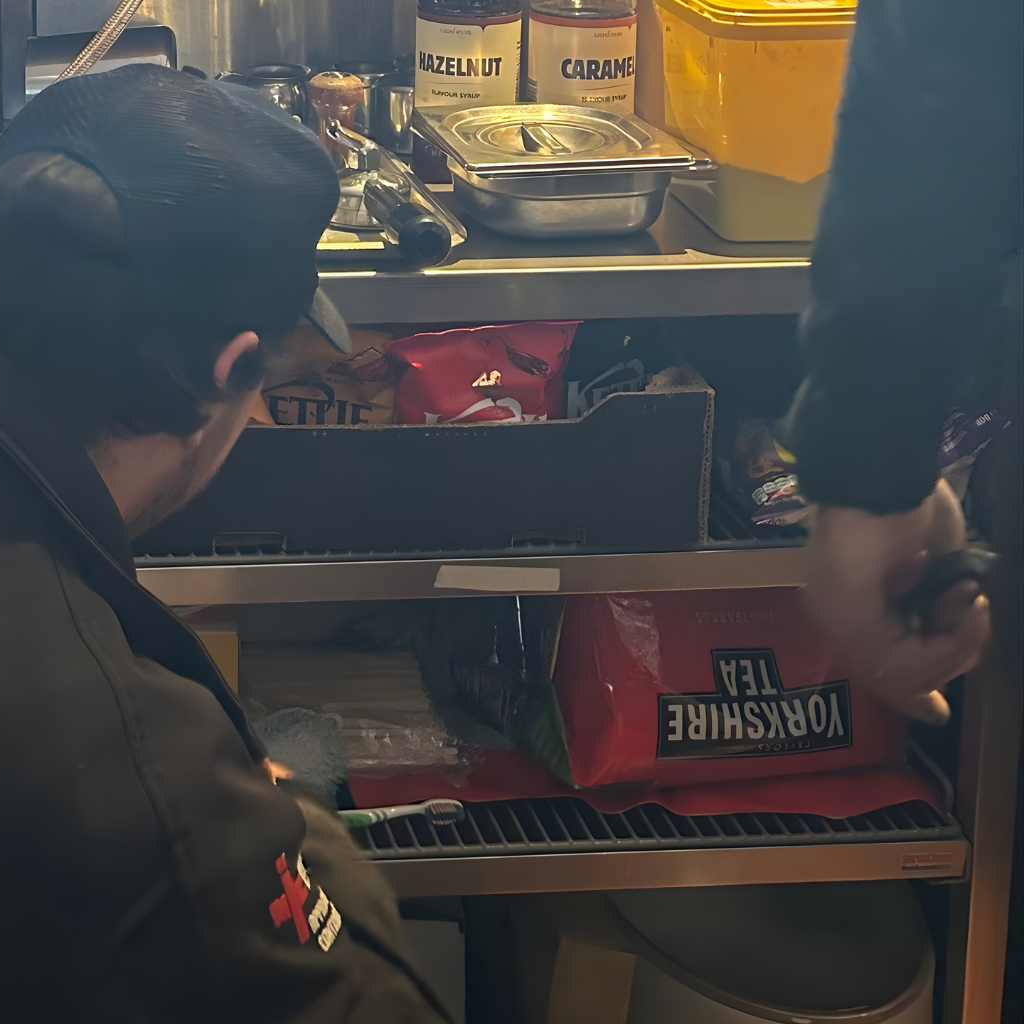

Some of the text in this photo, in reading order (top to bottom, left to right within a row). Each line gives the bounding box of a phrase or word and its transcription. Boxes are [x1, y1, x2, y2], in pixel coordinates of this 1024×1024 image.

[419, 50, 503, 77] HAZELNUT
[719, 659, 778, 697] TEA
[667, 692, 845, 741] YORKSHIRE
